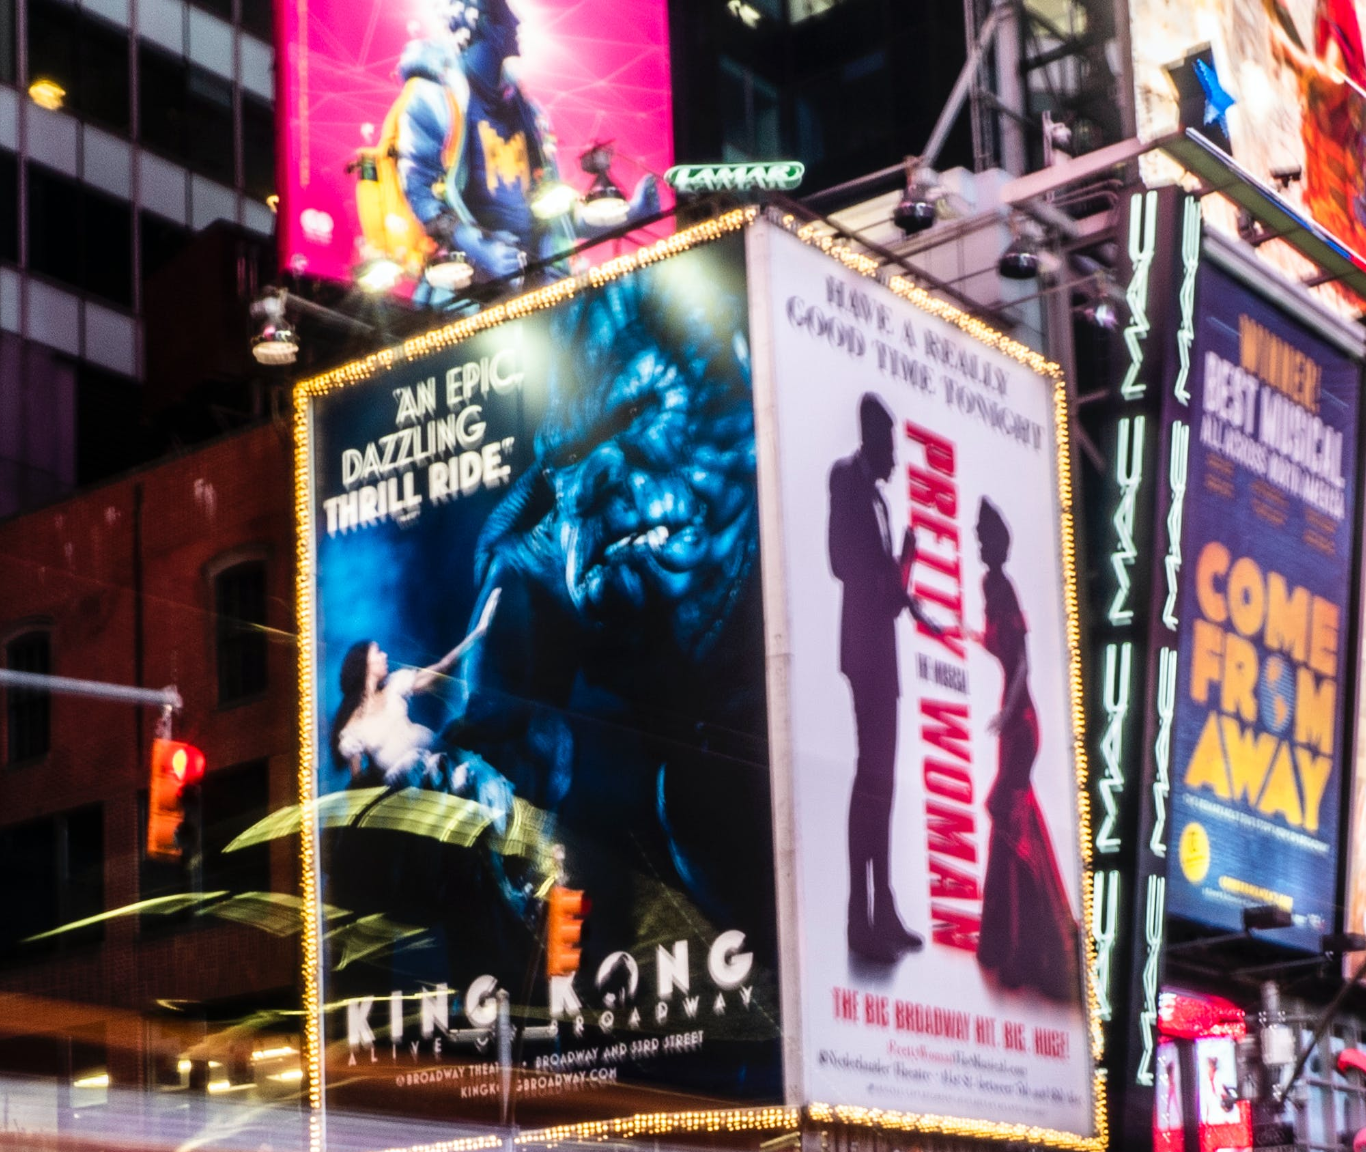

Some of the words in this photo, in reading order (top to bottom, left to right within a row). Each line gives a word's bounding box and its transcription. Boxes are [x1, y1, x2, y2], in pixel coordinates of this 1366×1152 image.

[675, 164, 790, 191] LAMAR
[785, 295, 866, 359] GOOD
[875, 340, 935, 394] TIME
[945, 376, 1046, 451] TONIGHT
[825, 274, 894, 335] HAVE
[902, 319, 918, 348] A
[924, 325, 1010, 397] REALLY
[342, 405, 486, 490] DAZZLING
[1203, 351, 1259, 436] BEST
[1258, 385, 1346, 490] MUSICAL
[323, 471, 422, 536] THRILL
[904, 419, 968, 660] PRETTY
[1195, 541, 1341, 680] COME
[1190, 617, 1338, 757] FROM
[919, 696, 982, 953] WOMAN
[1184, 708, 1334, 832] AWAY
[347, 975, 501, 1050] KING
[550, 929, 754, 1018] KONG
[535, 1048, 598, 1070] BROADWAY
[603, 1042, 628, 1060] AND
[663, 1030, 705, 1050] STREET
[832, 986, 859, 1021] THE
[864, 993, 889, 1027] BIG
[894, 999, 971, 1042] BROADWAY
[1034, 1026, 1071, 1061] HUGE!
[347, 1036, 442, 1067] ALIVE
[406, 1066, 466, 1087] BROADWAY
